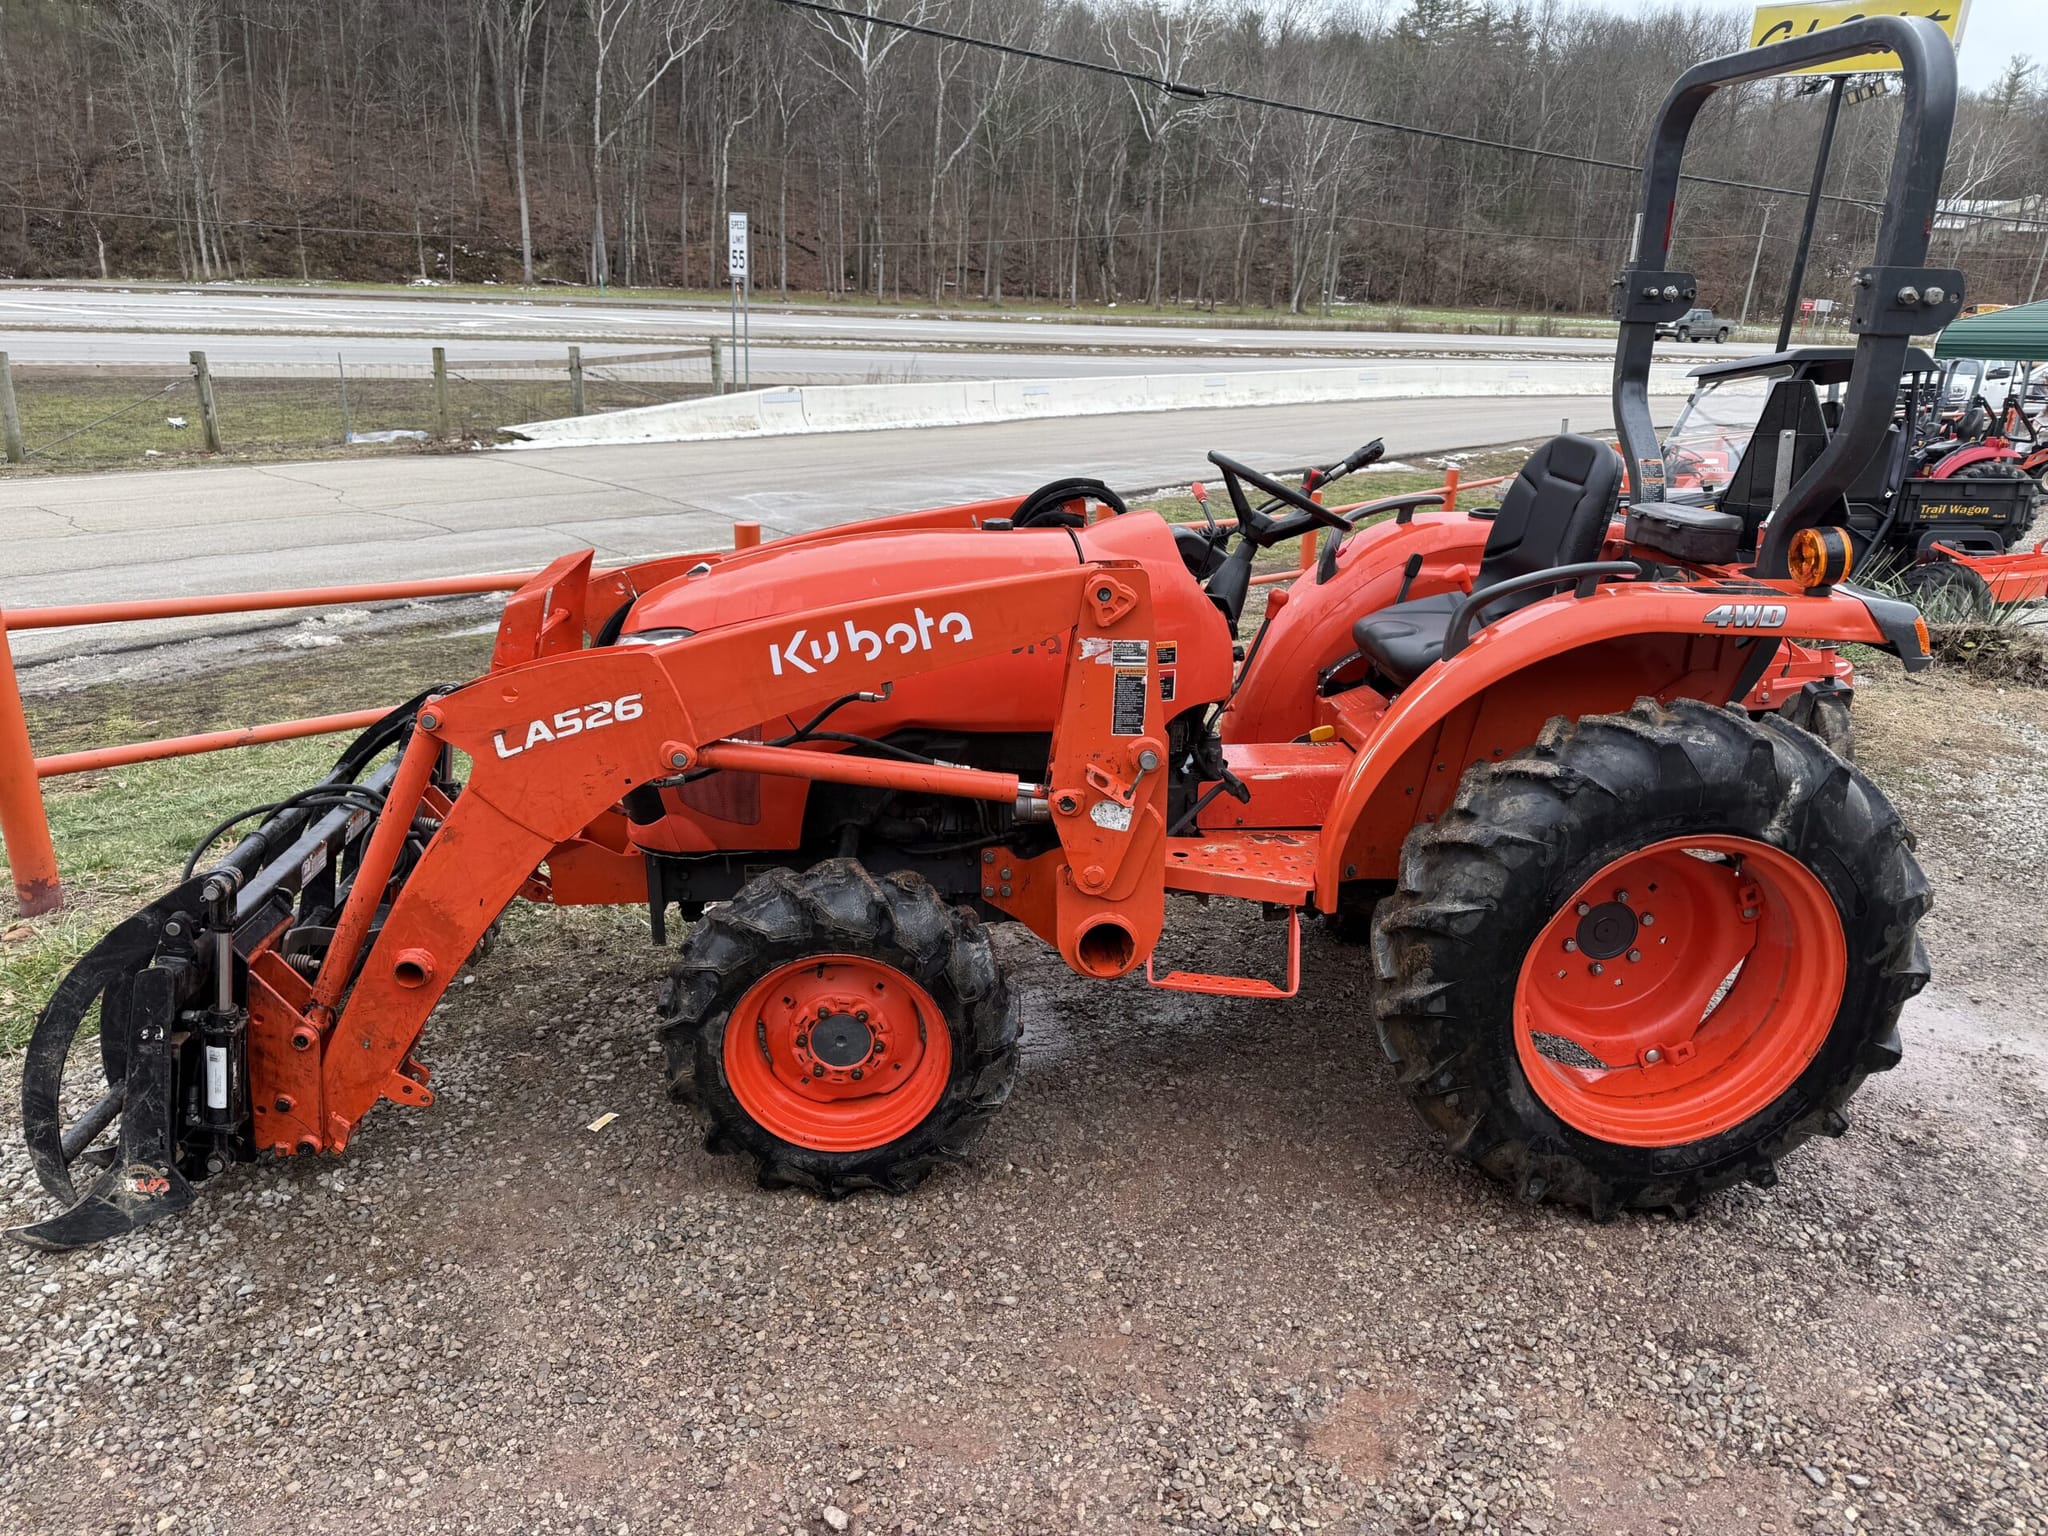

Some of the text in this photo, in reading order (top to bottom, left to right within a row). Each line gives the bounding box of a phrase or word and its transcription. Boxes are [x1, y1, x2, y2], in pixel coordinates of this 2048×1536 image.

[730, 220, 745, 229] SPEED
[732, 235, 745, 244] LIMIT
[732, 249, 745, 269] 55
[1920, 504, 1990, 516] Trail Wagon
[1703, 604, 1788, 629] 4WD
[769, 607, 974, 676] Kubota
[493, 693, 644, 760] LA526
